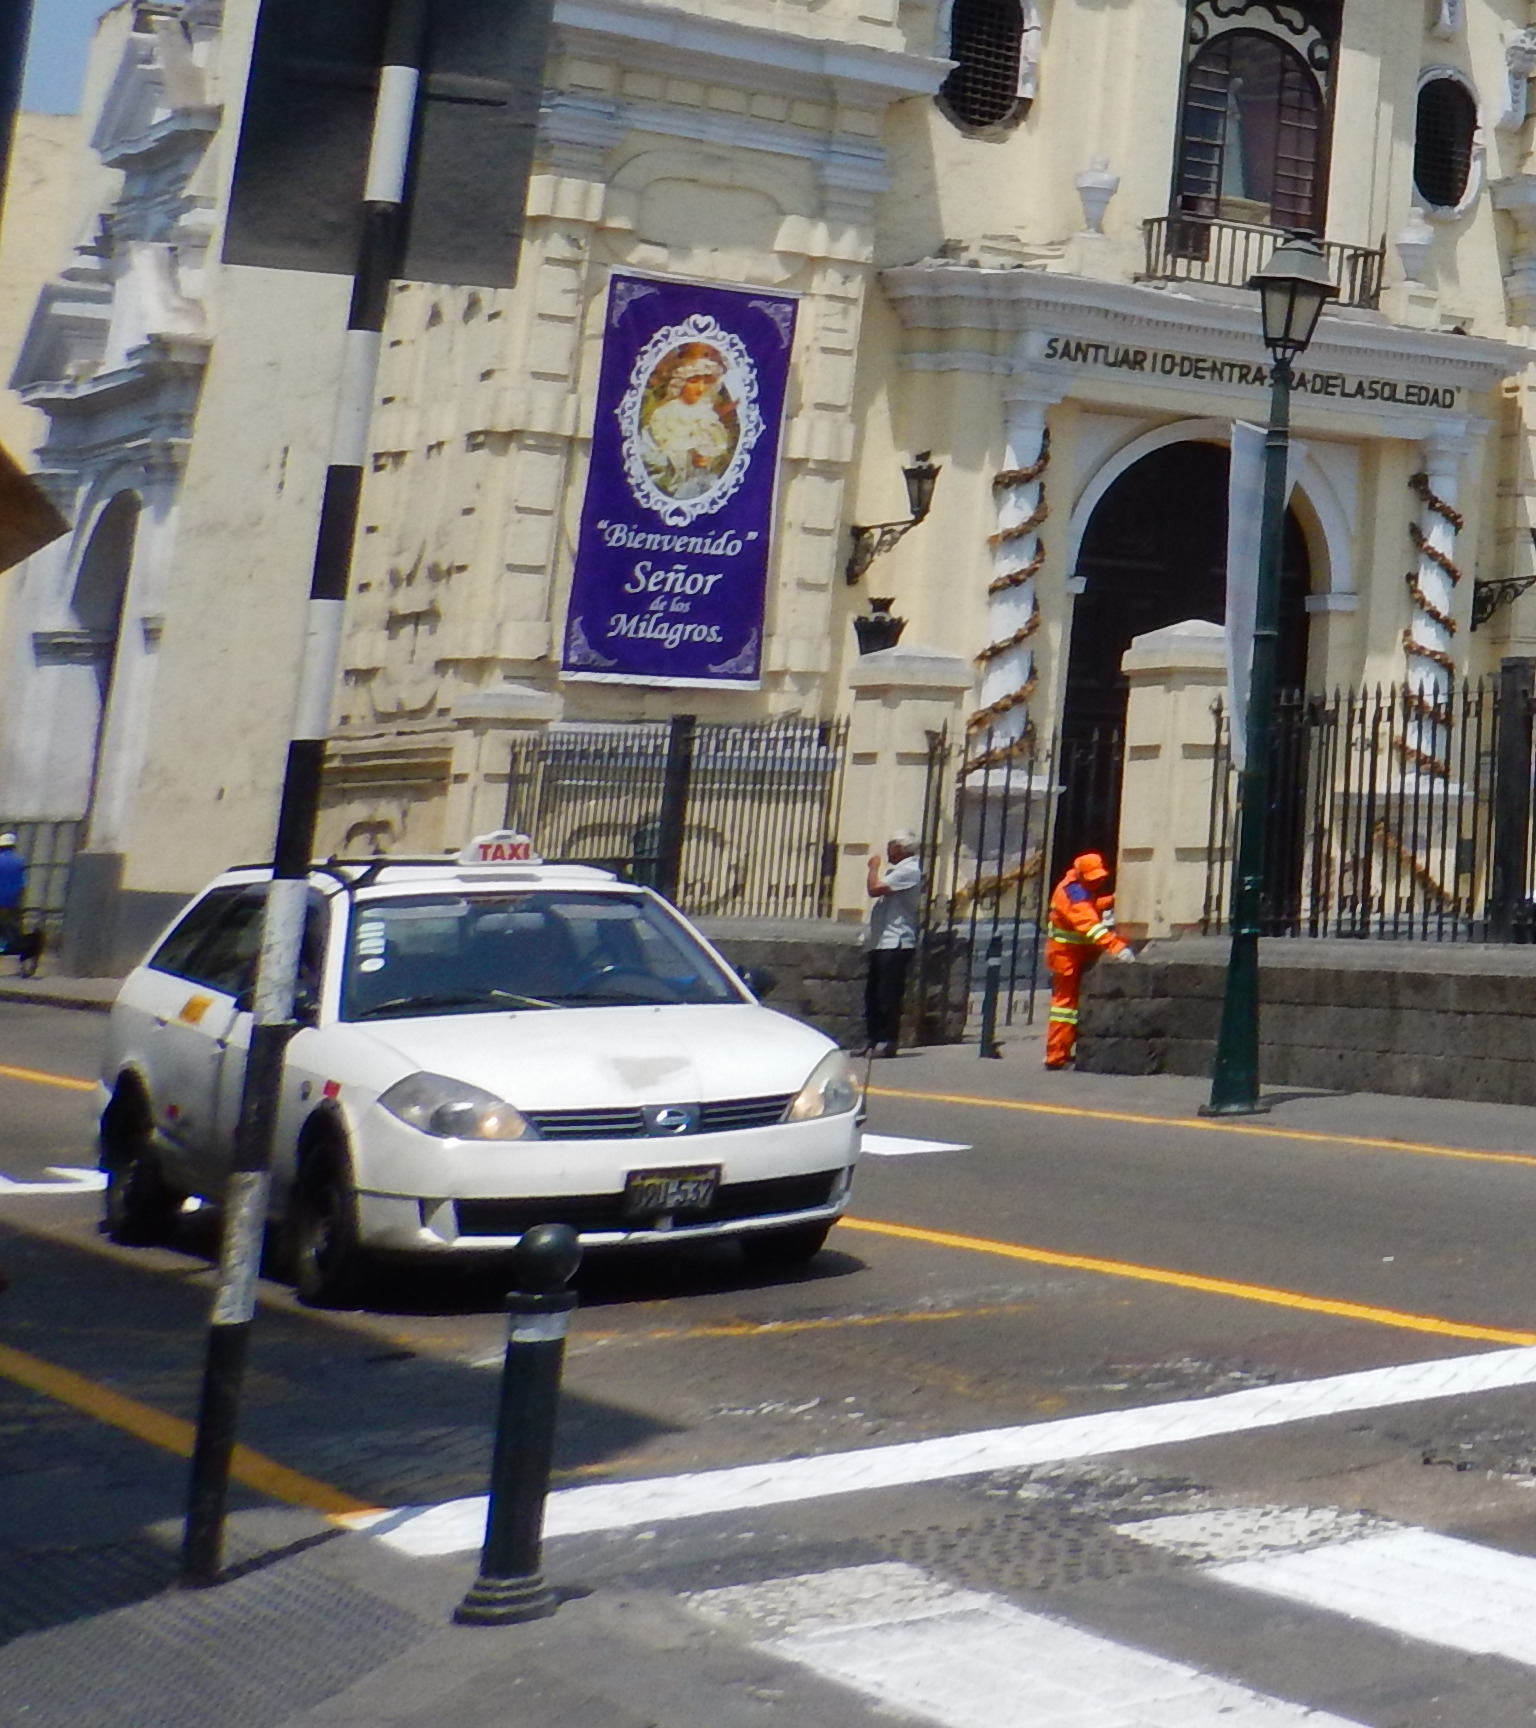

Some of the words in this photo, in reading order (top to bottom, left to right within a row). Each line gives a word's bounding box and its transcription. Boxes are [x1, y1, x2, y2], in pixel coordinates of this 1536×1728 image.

[624, 560, 723, 594] Señor
[648, 594, 668, 613] de
[669, 595, 693, 614] los
[607, 613, 723, 649] Milagros.
[480, 843, 530, 862] TAXI
